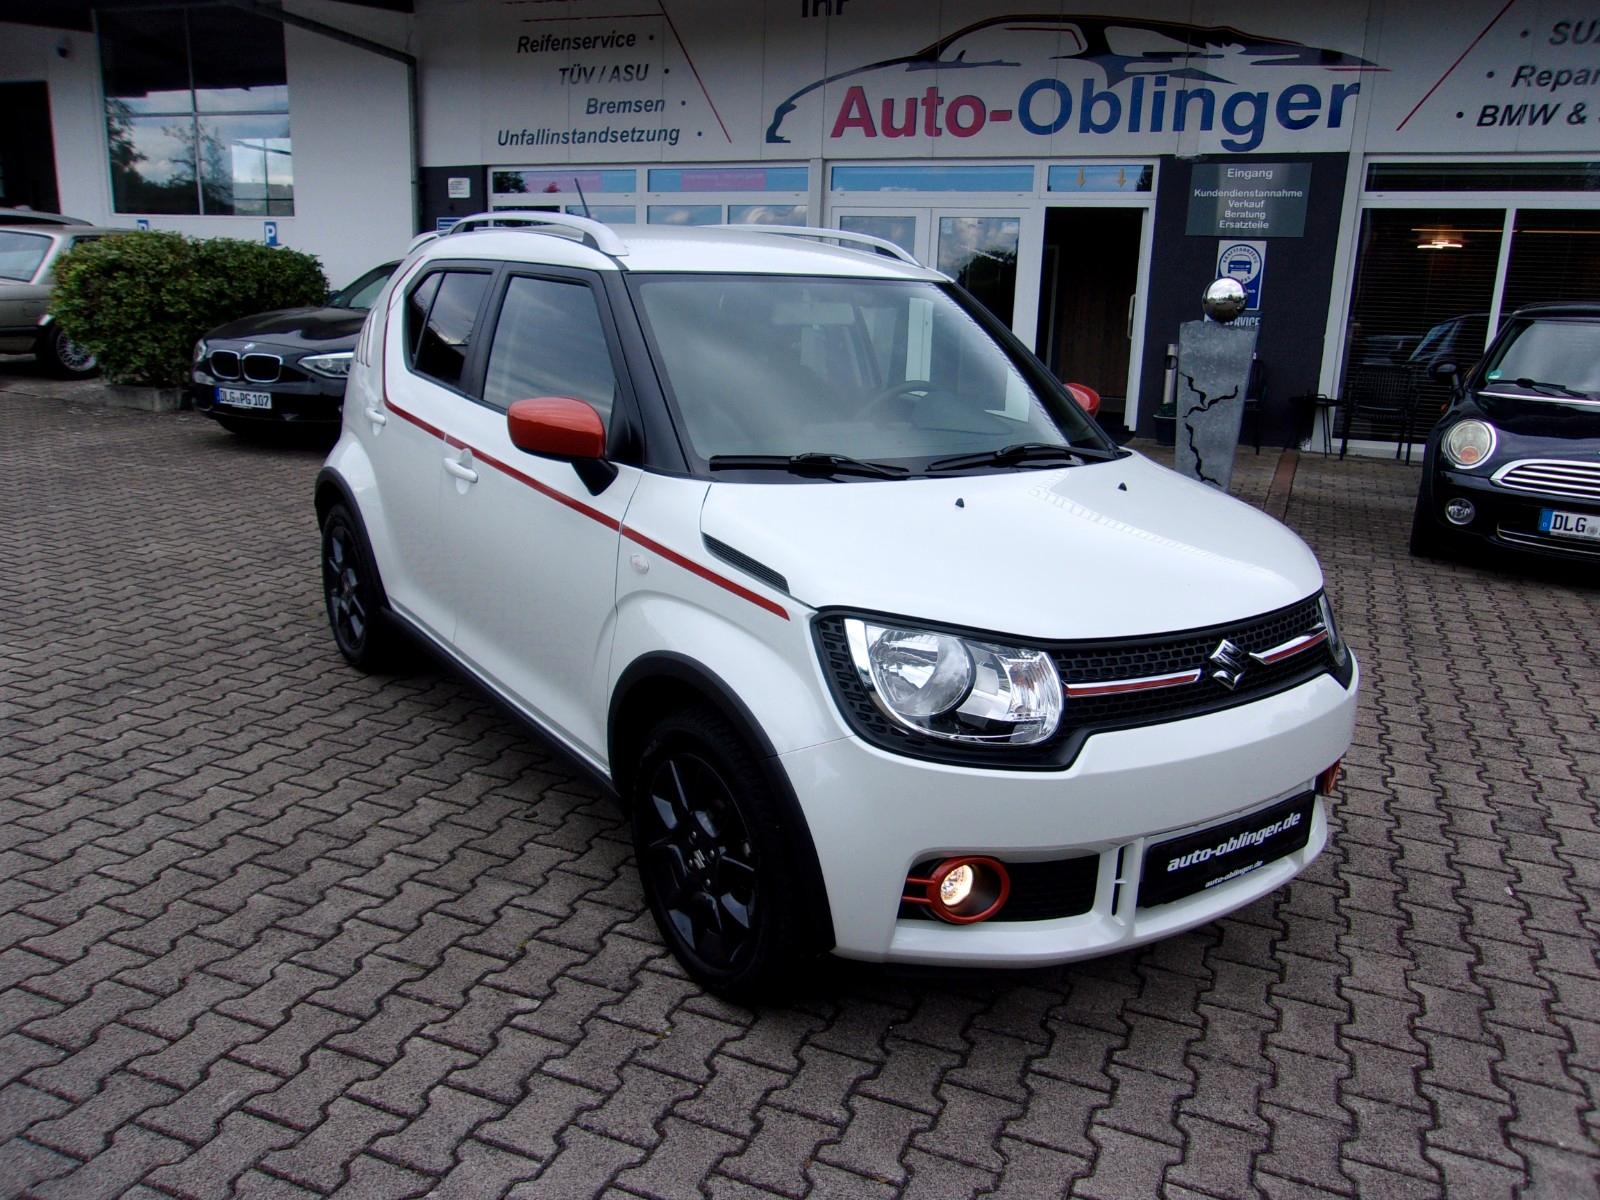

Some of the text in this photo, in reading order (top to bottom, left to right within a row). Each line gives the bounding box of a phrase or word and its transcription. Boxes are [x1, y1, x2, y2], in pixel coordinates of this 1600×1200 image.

[517, 32, 637, 54] Reifenservice
[558, 65, 596, 85] TÜV
[609, 64, 649, 83] ASU
[586, 98, 666, 115] Bremsen
[830, 75, 1360, 153] Auto-Oblinger
[1477, 102, 1587, 127] BMW &
[497, 126, 680, 147] Unfallinstandsetzung
[1227, 168, 1273, 180] Eingang
[1194, 189, 1303, 198] Kundendienstannahme
[1228, 200, 1265, 208] Verkauf
[1219, 221, 1269, 229] Ersatzteile
[1224, 211, 1266, 220] Beratung
[266, 225, 276, 243] P
[1552, 514, 1587, 533] DLG
[1166, 812, 1301, 872] auto-oblinger.de
[1204, 860, 1263, 889] auto-oblinger.de
